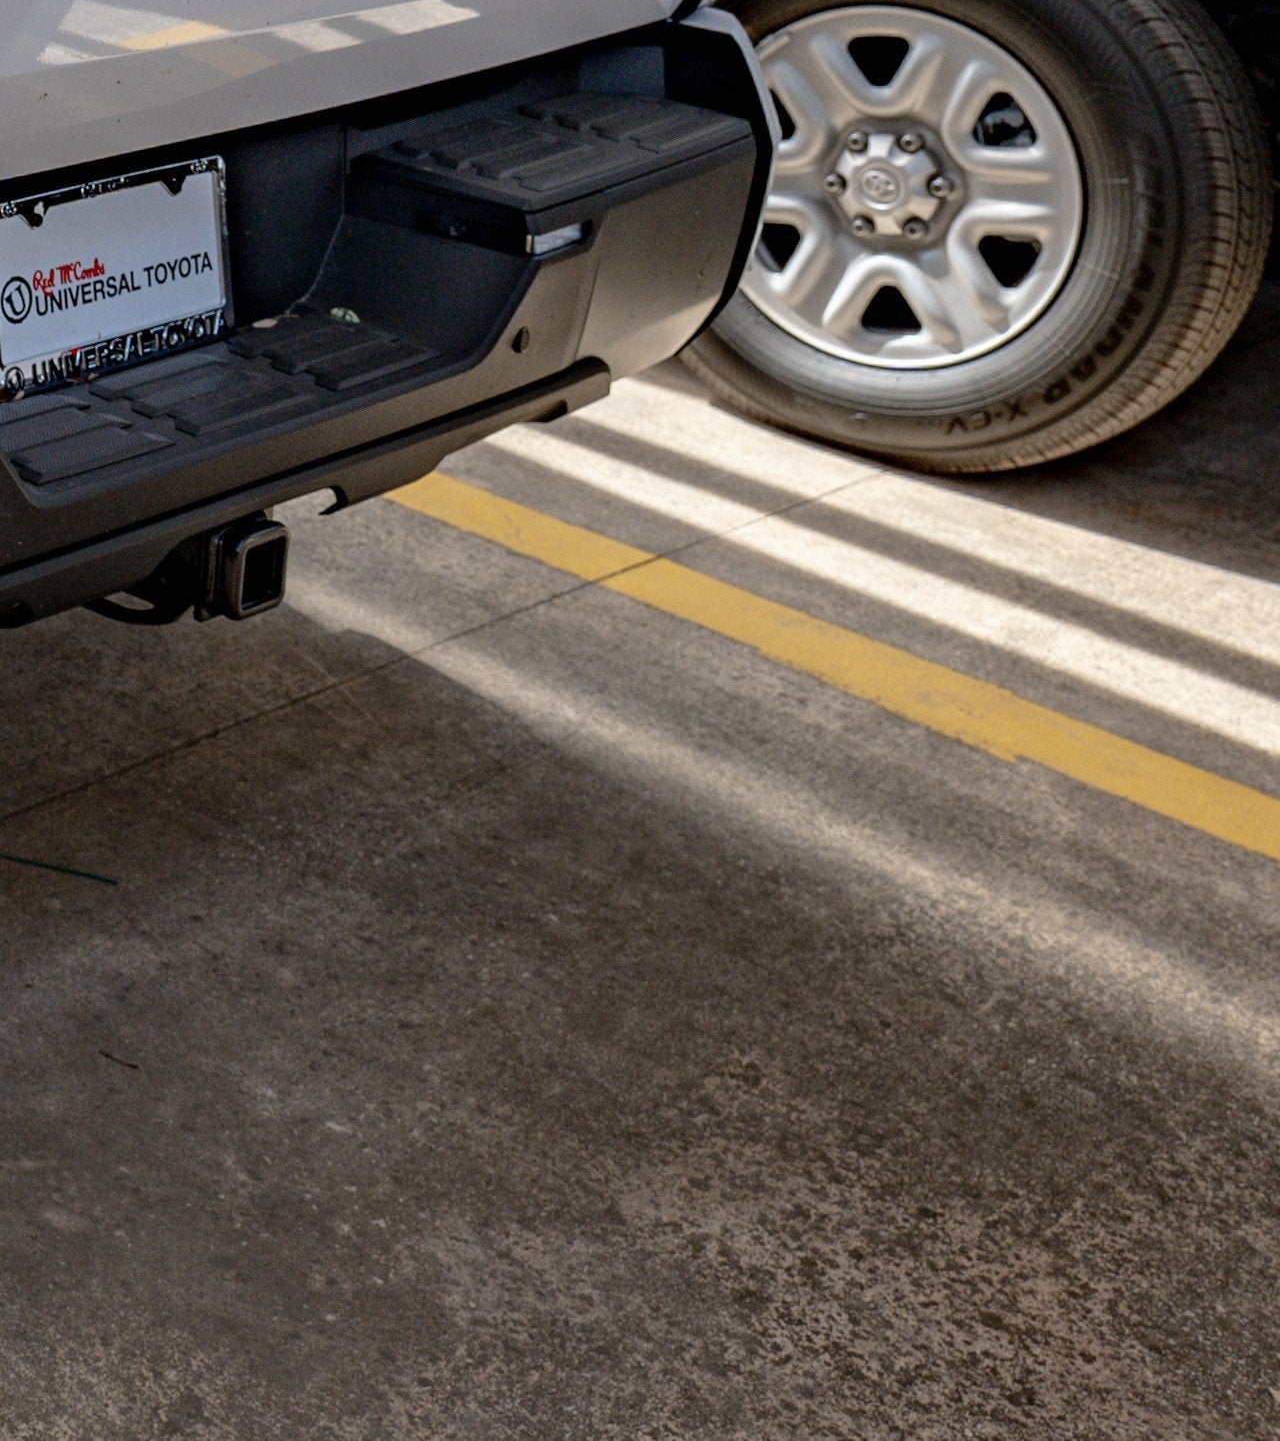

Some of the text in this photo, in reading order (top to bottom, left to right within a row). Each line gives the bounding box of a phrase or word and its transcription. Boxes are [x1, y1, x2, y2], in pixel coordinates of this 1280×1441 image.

[32, 269, 56, 295] Red
[34, 252, 213, 316] UNIVERSAL TOYOTA
[31, 309, 226, 387] UNIVERSAL TOYOTA
